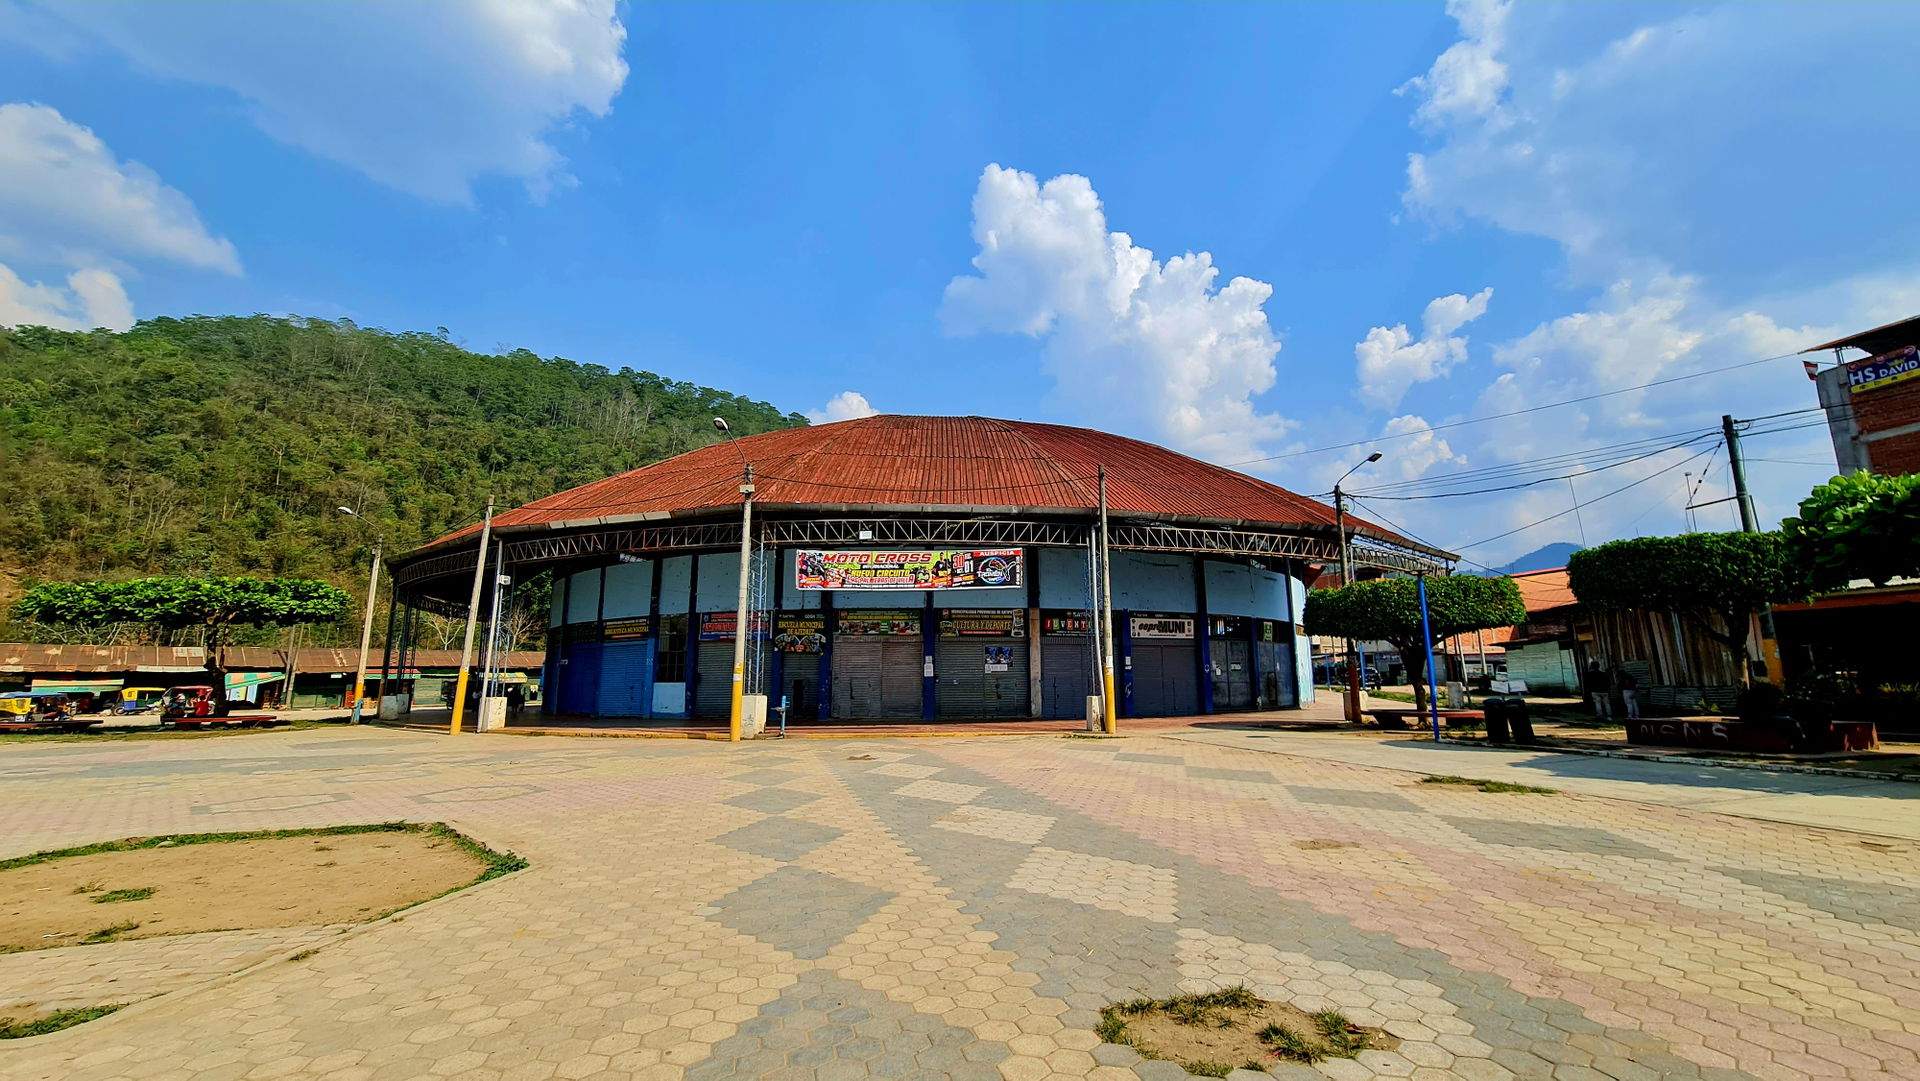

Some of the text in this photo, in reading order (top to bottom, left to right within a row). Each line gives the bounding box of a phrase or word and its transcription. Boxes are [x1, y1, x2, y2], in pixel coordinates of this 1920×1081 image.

[1849, 360, 1918, 386] HS DAVID
[822, 553, 933, 563] MOTO CROSS
[953, 555, 965, 569] 30
